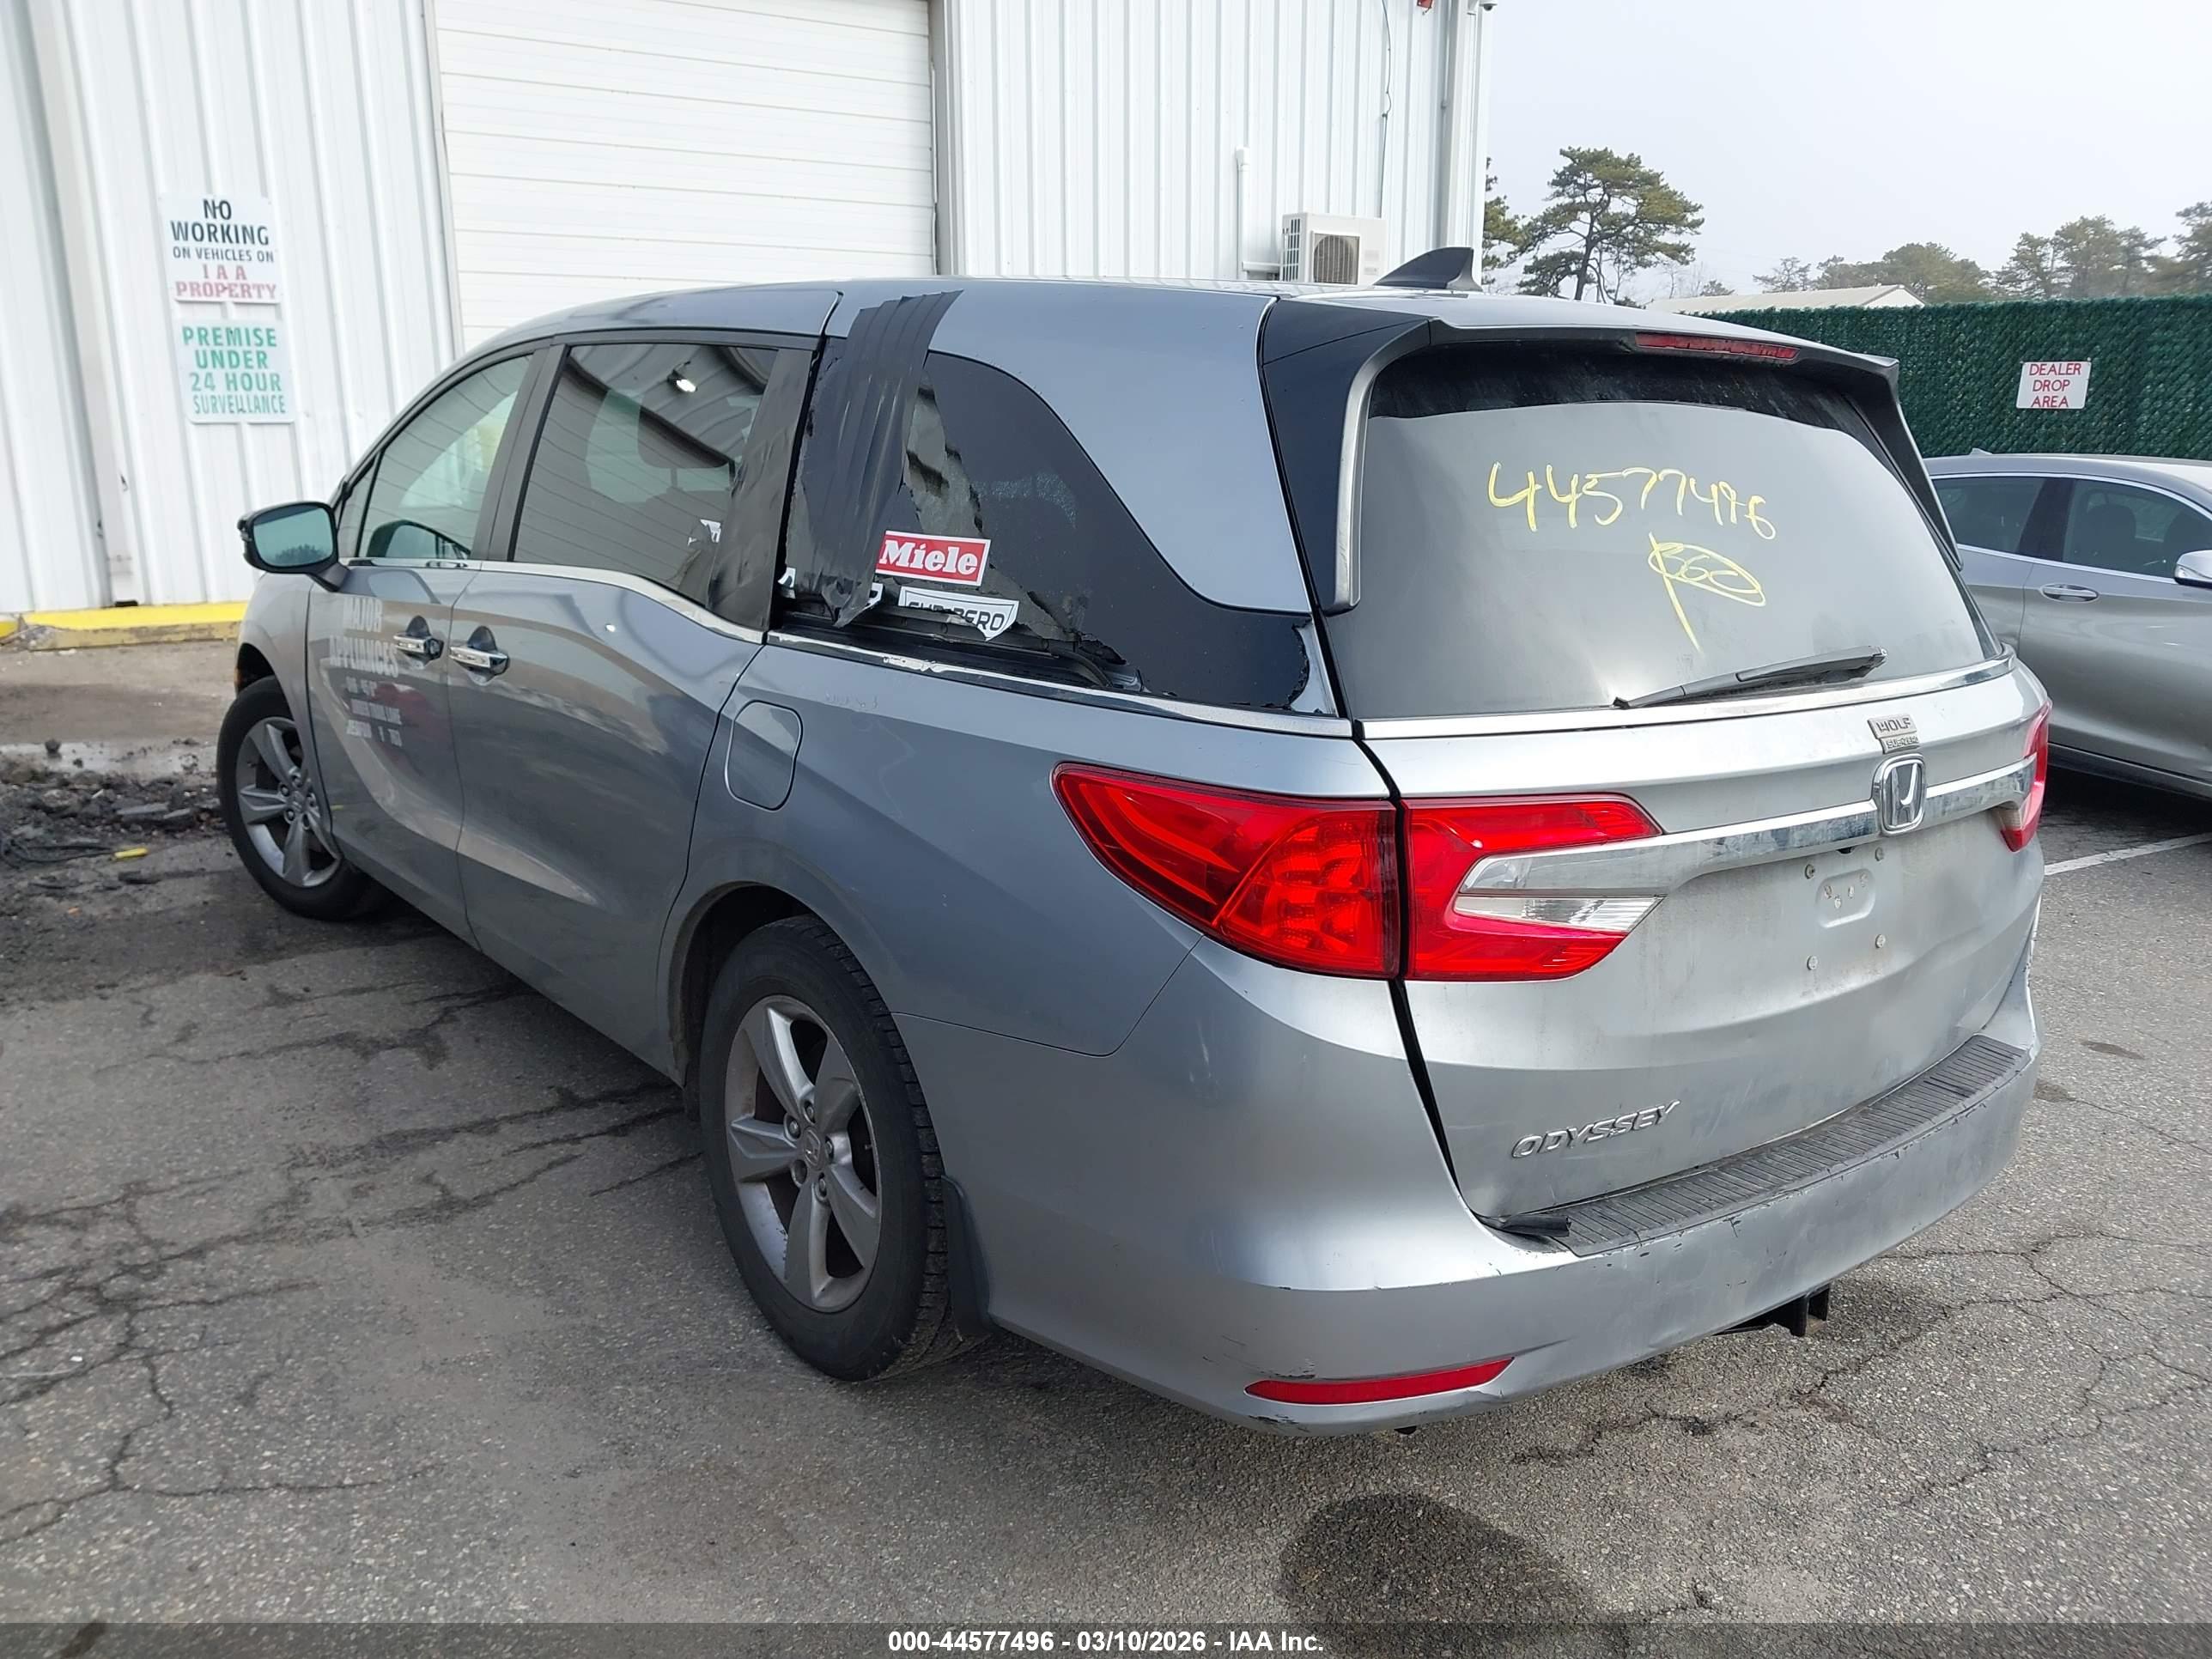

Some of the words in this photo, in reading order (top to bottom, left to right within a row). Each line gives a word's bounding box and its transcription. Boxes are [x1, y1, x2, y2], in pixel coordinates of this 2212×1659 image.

[204, 198, 232, 220] NO
[171, 221, 269, 245] WORKING
[173, 246, 191, 258] ON
[196, 247, 252, 262] VEHICLES
[257, 250, 274, 262] ON
[175, 282, 276, 299] PROPERTY
[182, 326, 277, 347] PREMISE
[195, 349, 268, 369] UNDER
[2029, 362, 2081, 376] DEALER
[190, 373, 216, 392] 24
[225, 373, 282, 392] HOUR
[2033, 380, 2070, 392] DROP
[193, 394, 286, 414] SURVEILLANCE
[2031, 396, 2069, 408] AREA
[879, 539, 978, 575] Miele
[1875, 717, 1911, 732] WOLF
[1511, 1099, 1680, 1158] ODYSSEY
